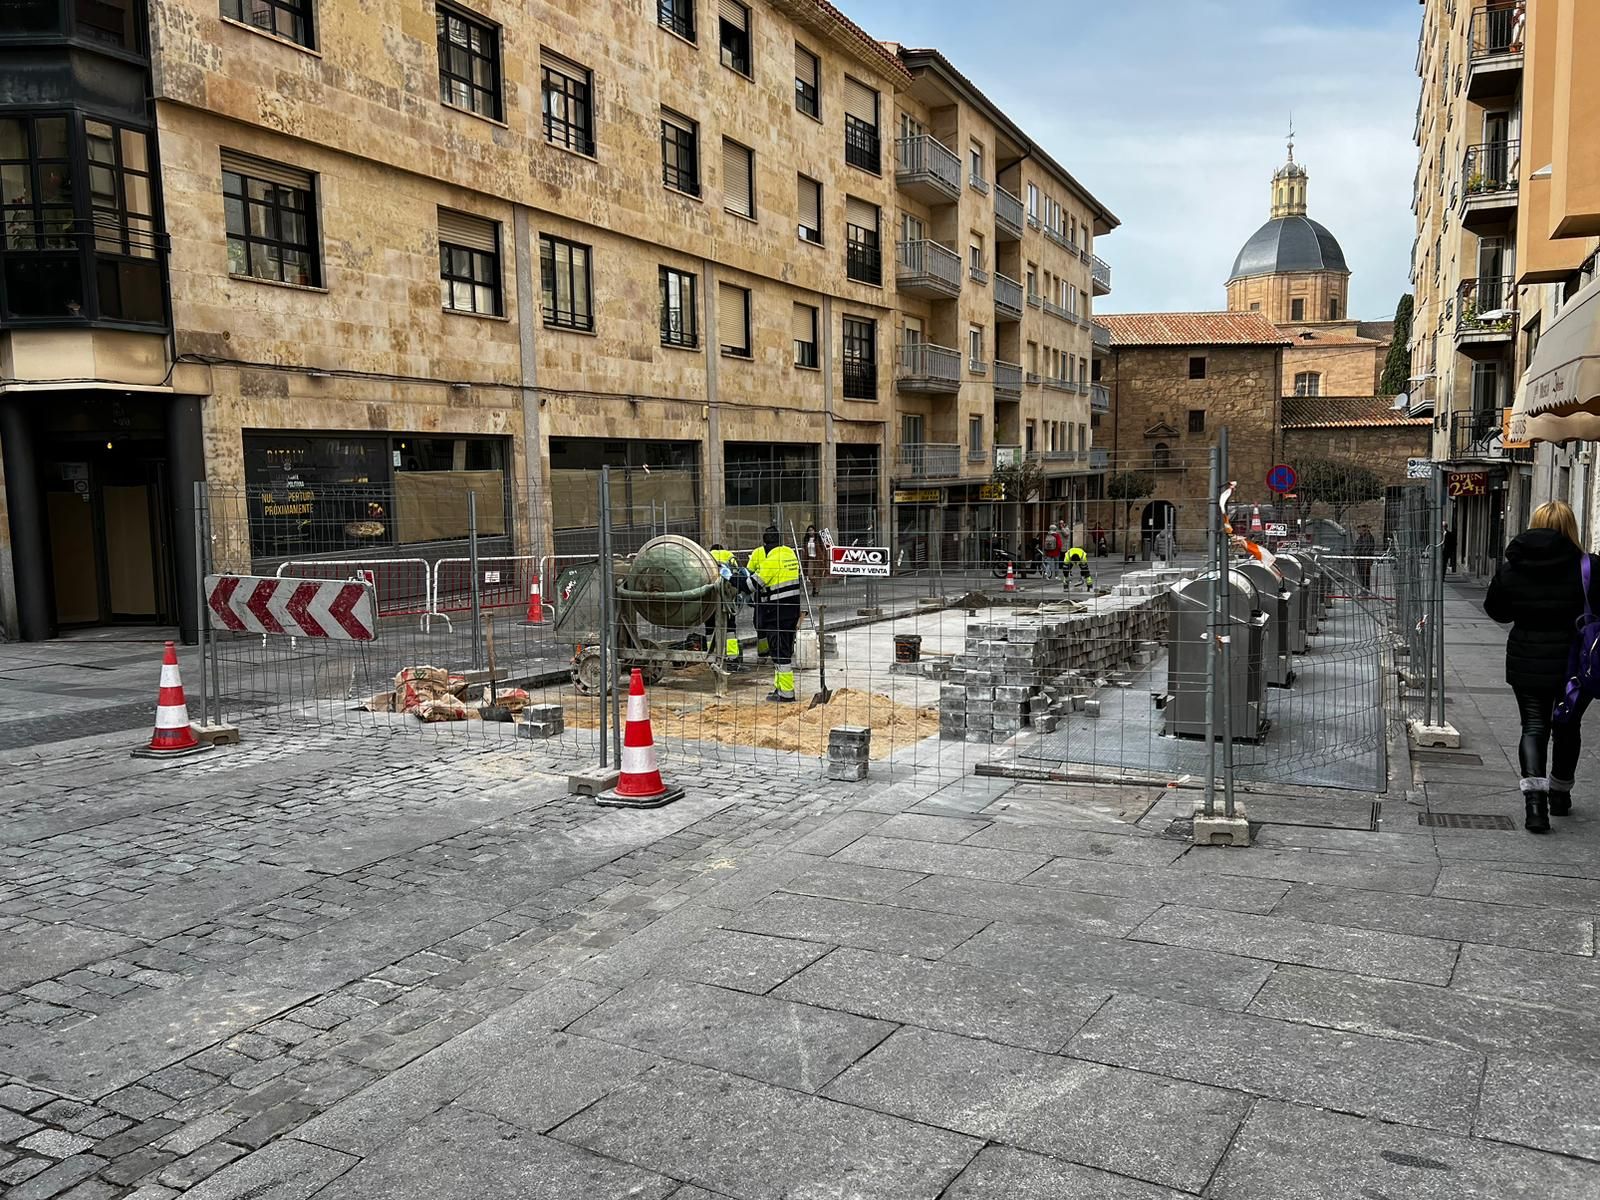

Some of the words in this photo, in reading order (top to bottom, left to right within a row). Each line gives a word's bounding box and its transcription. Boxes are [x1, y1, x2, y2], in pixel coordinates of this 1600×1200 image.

[1450, 473, 1484, 482] OPEN
[835, 549, 882, 564] AMAQ
[832, 566, 860, 574] ALQUILER
